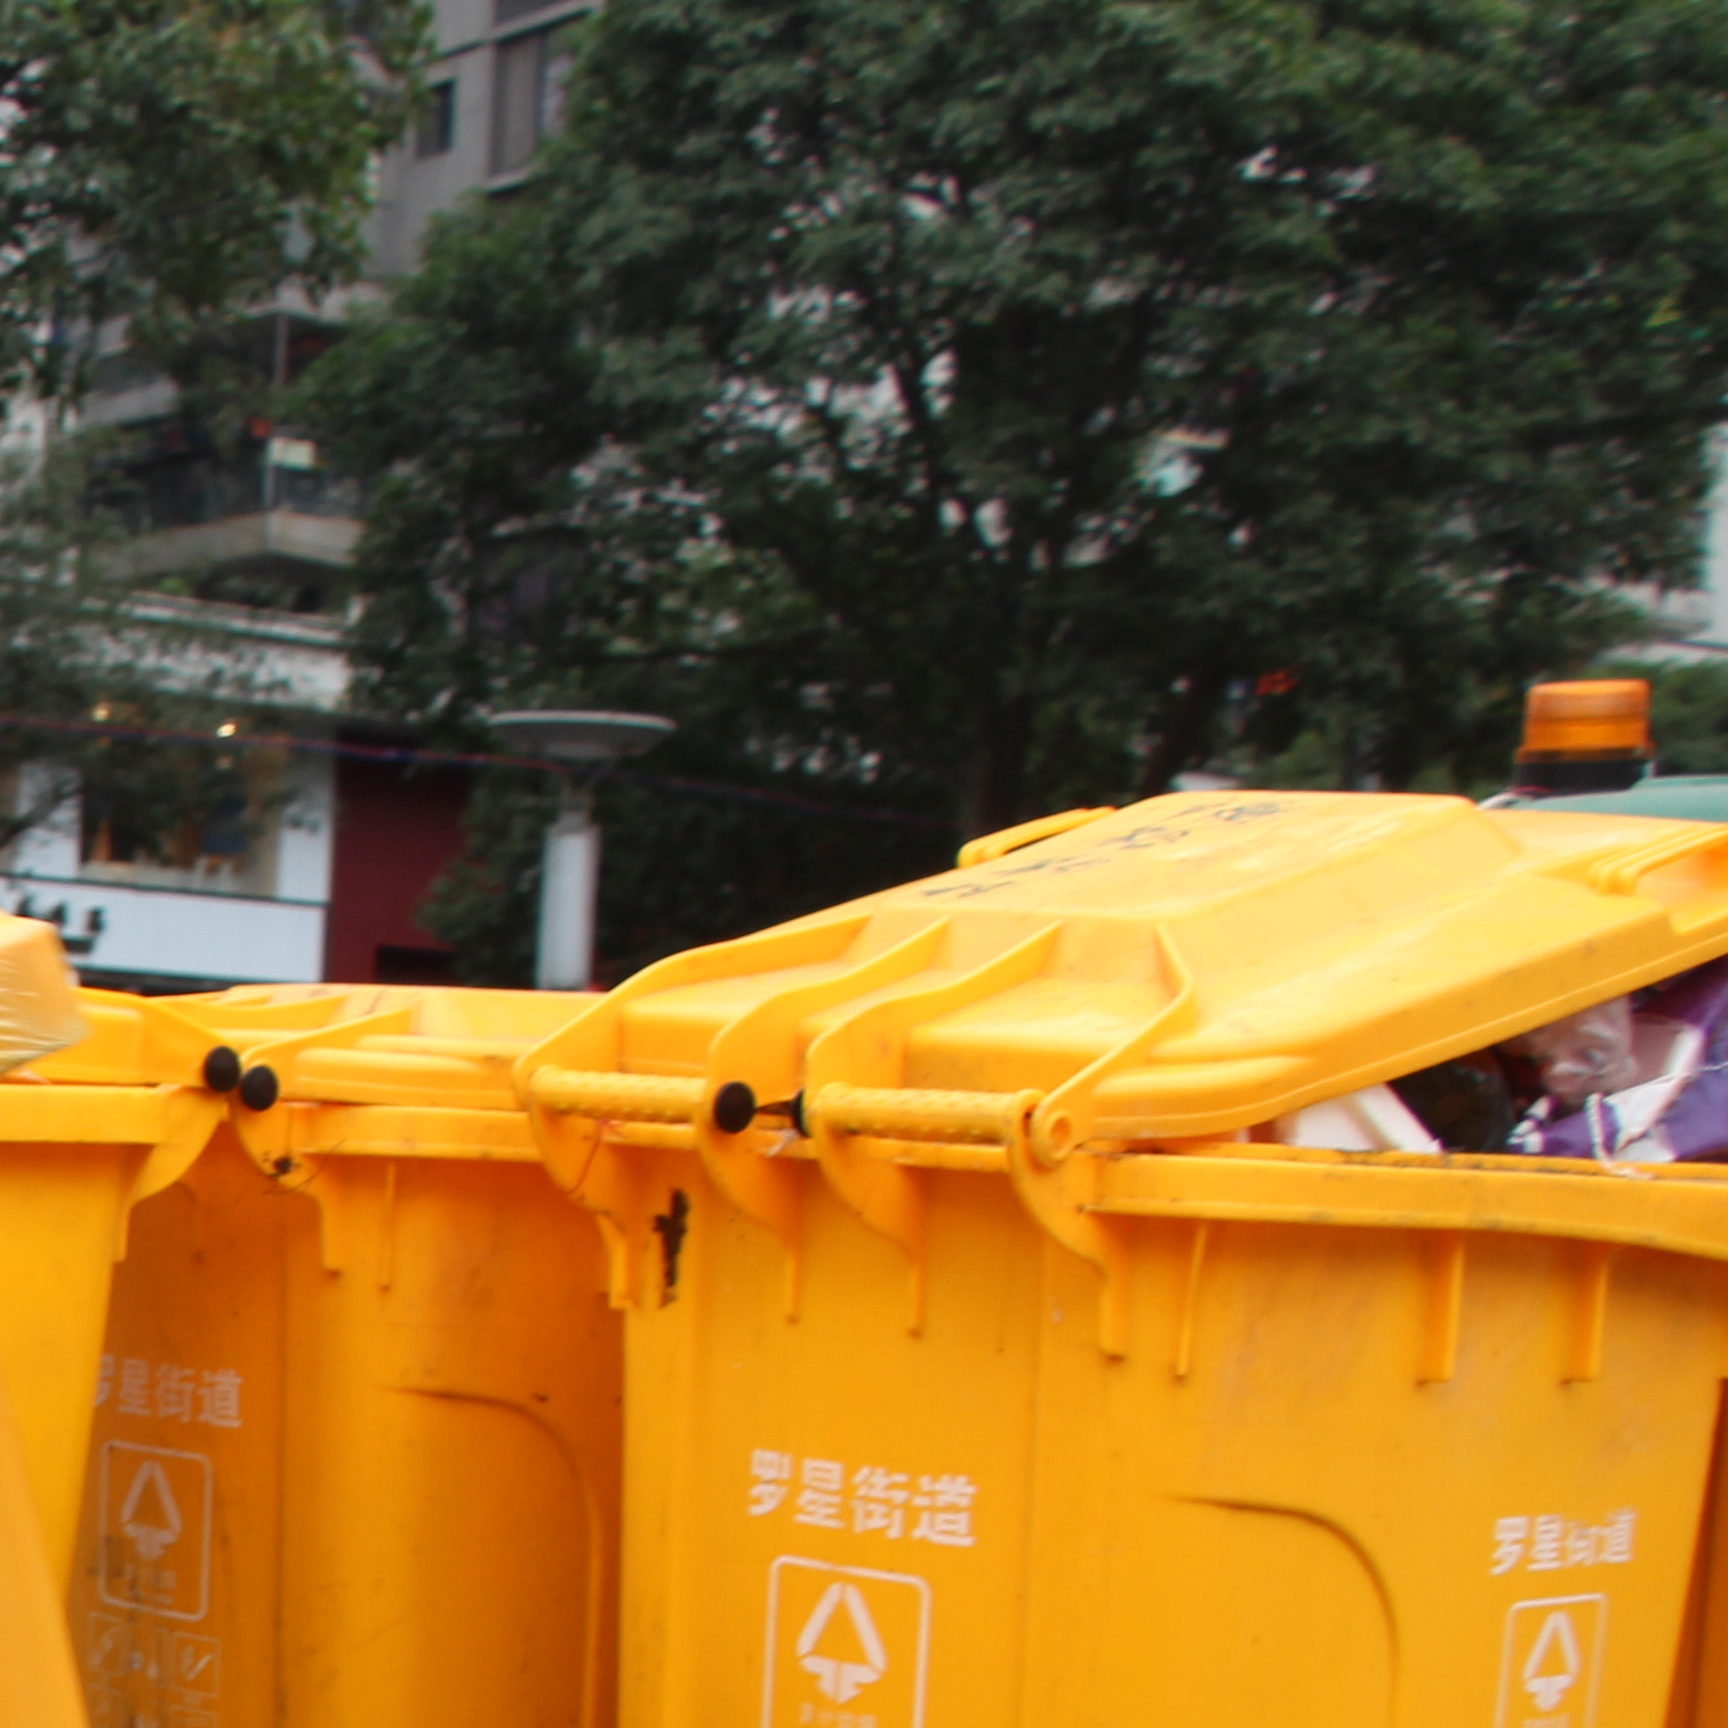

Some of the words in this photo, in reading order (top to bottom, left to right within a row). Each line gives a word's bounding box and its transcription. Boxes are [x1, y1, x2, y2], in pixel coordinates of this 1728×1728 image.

[748, 1448, 977, 1548] 罗星街道
[1490, 1507, 1636, 1575] 罗星街道
